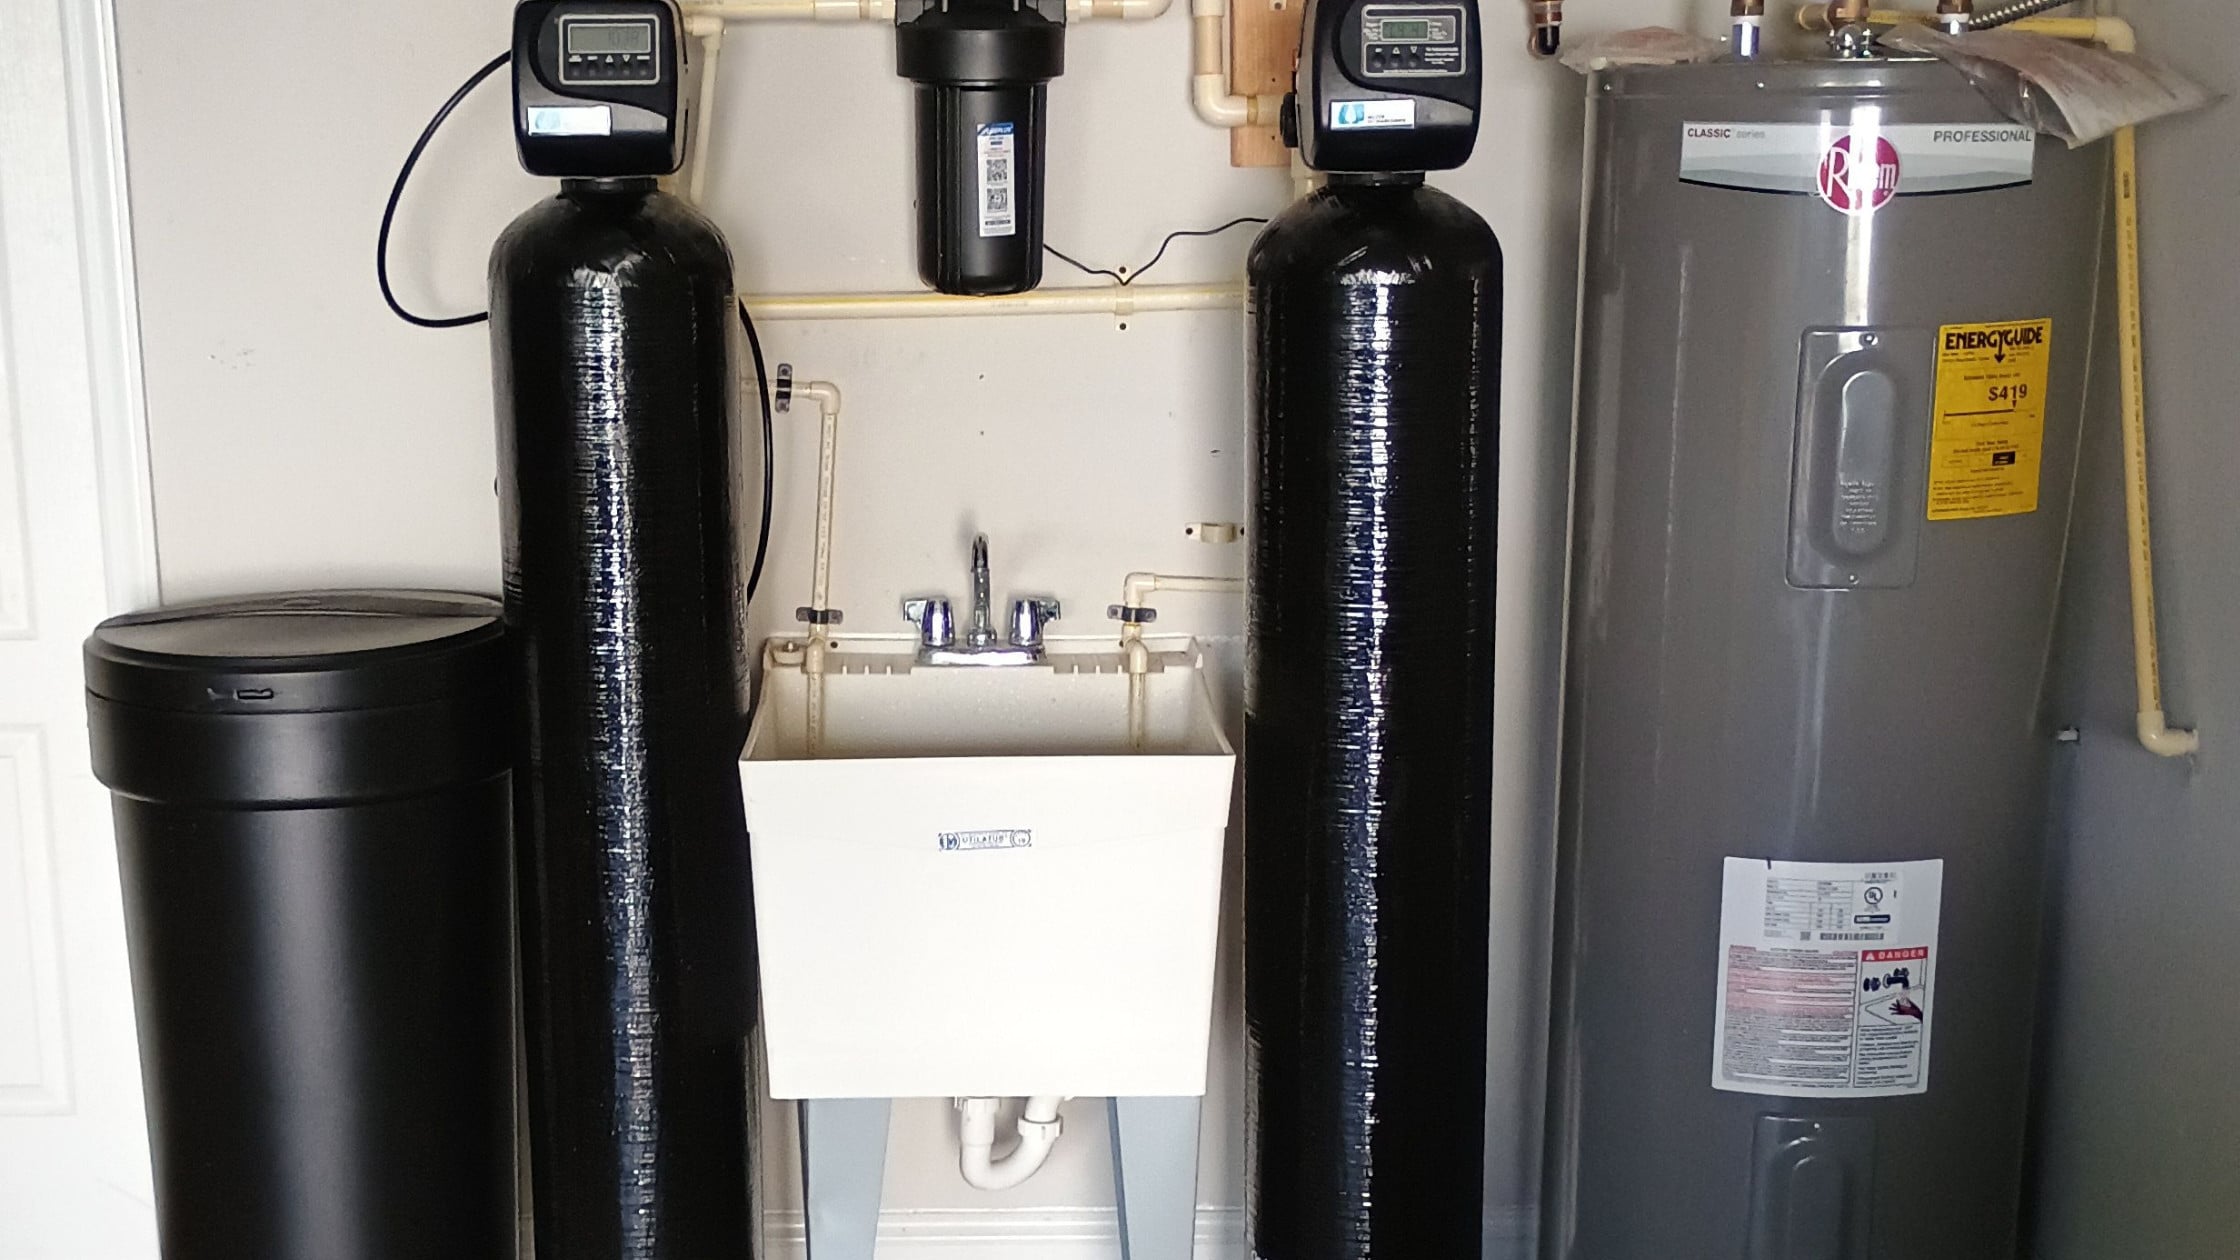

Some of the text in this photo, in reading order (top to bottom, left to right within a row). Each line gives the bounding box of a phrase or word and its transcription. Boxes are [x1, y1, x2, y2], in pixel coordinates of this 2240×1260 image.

[1687, 128, 1766, 139] CLASSIC series
[1933, 130, 2033, 142] PROFESSIONAL
[1945, 326, 2043, 350] ENERGYGUIDE
[1878, 949, 1924, 960] DANGER
